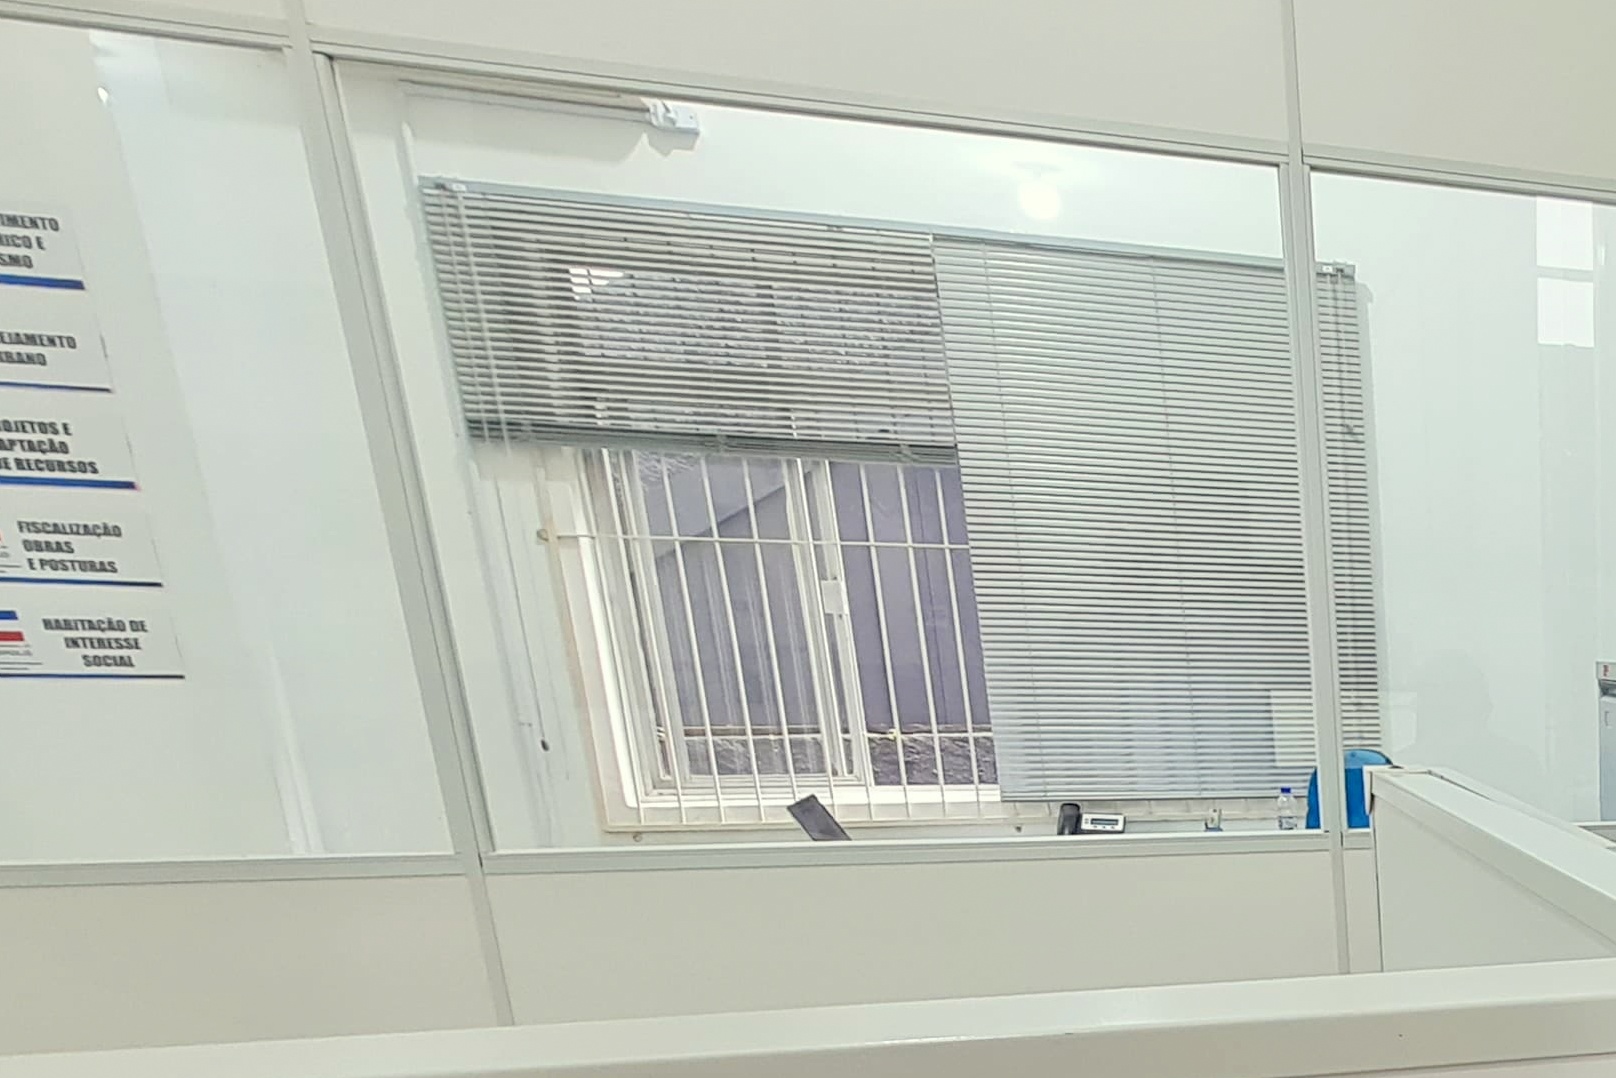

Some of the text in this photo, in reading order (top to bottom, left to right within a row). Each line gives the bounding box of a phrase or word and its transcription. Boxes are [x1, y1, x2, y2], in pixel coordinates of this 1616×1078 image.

[0, 419, 72, 436] OJETOS E
[14, 458, 99, 474] RECURSOS
[17, 520, 122, 537] FISCALIZAÇÃO
[22, 540, 74, 554] OBRAS
[27, 558, 36, 570] E
[39, 559, 118, 573] POSTURAS
[42, 617, 148, 633] HABITAÇÃO DE
[64, 637, 141, 650] INTERESSE
[81, 655, 135, 667] SOCIAL
